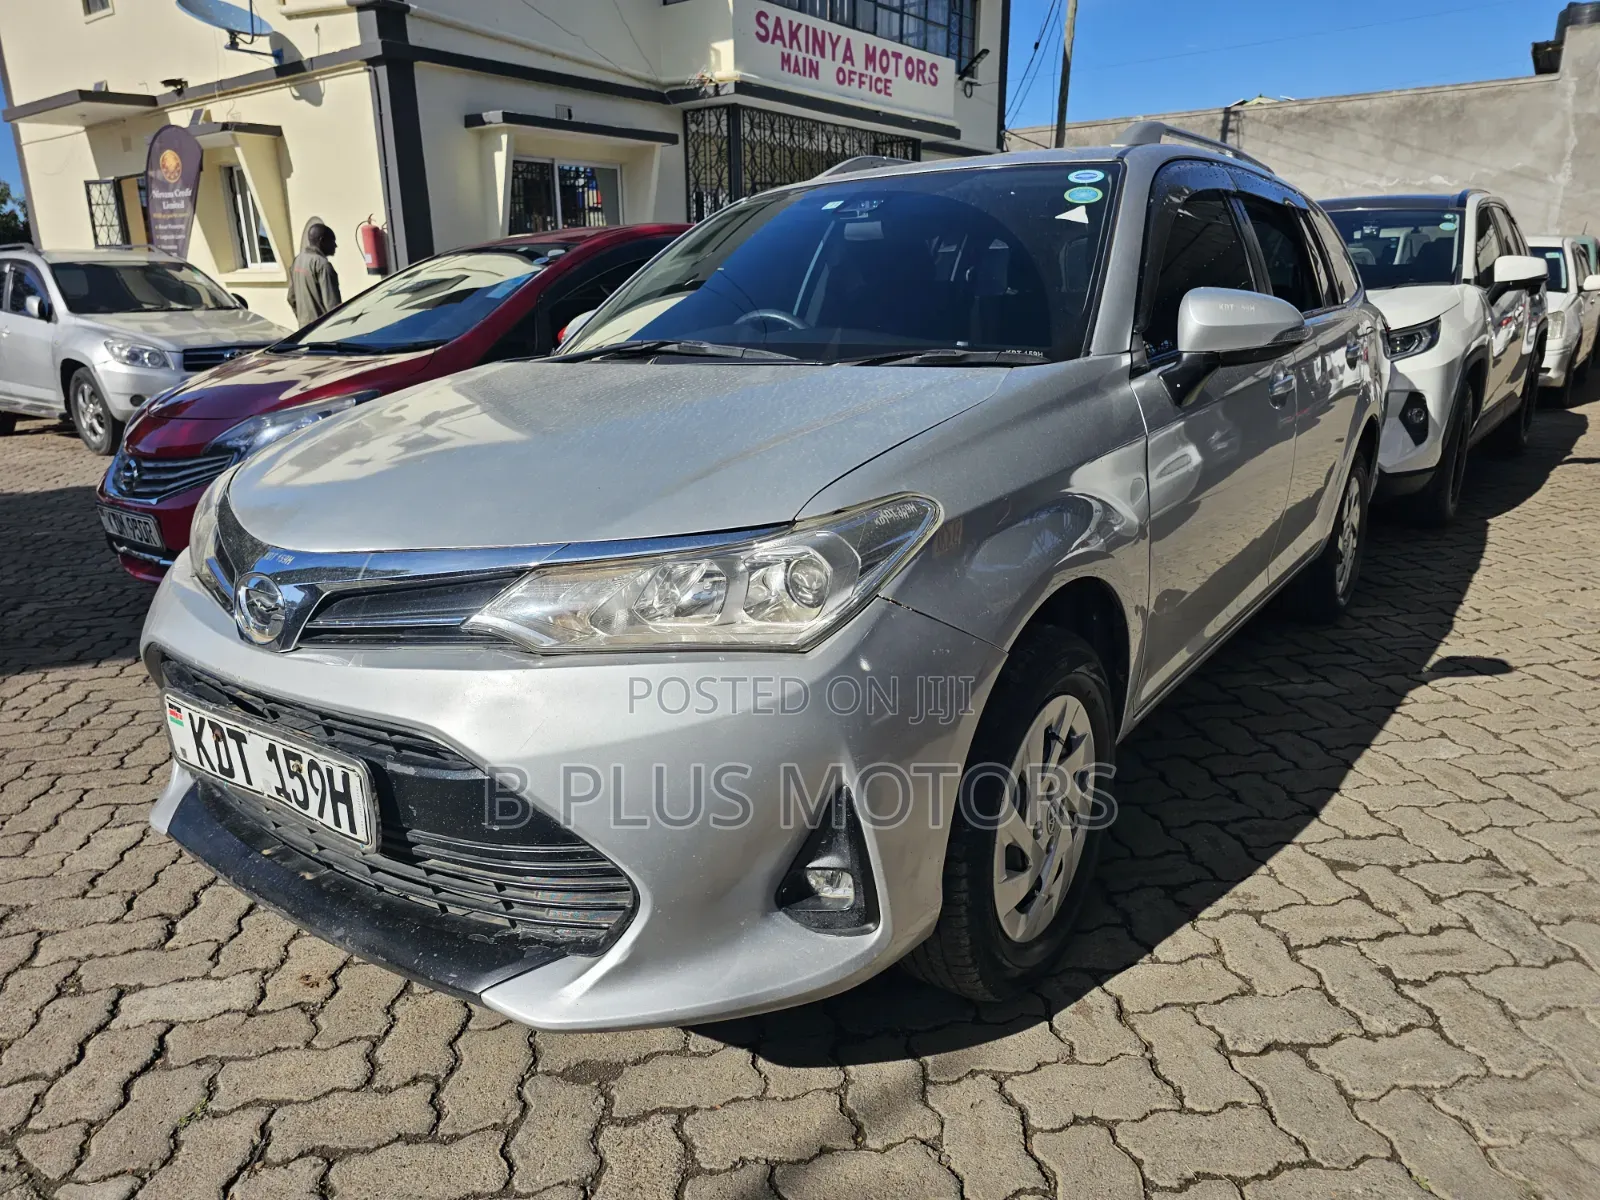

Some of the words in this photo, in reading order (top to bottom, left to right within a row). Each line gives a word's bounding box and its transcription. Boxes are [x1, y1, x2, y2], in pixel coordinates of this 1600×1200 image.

[755, 10, 855, 67] SAKINYA
[864, 43, 939, 87] MOTORS
[780, 51, 820, 80] MAIN
[836, 66, 893, 97] OFFICE
[162, 200, 185, 209] Limited
[188, 712, 254, 787] KDT
[265, 743, 358, 836] 159H
